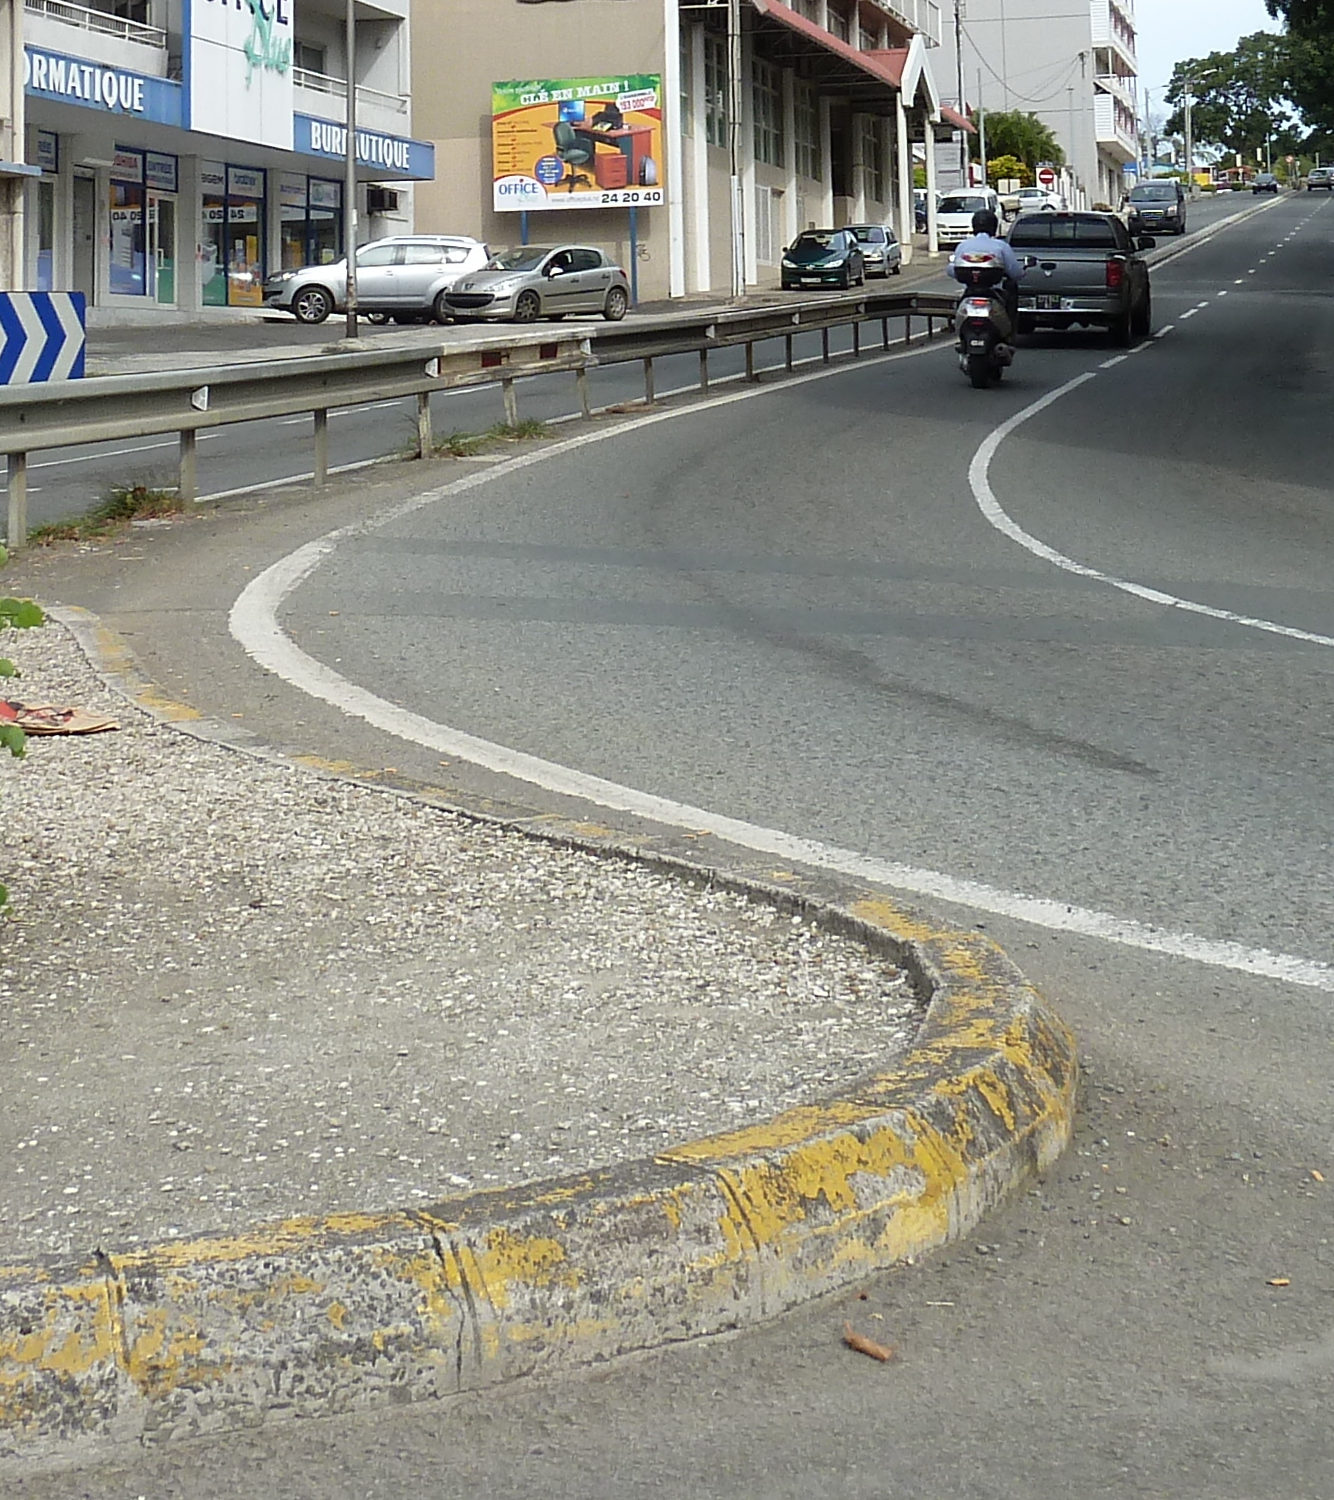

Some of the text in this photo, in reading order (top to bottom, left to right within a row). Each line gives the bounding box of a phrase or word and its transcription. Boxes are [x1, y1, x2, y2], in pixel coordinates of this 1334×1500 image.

[498, 179, 539, 196] OFFICE
[601, 191, 661, 204] 24 20 40
